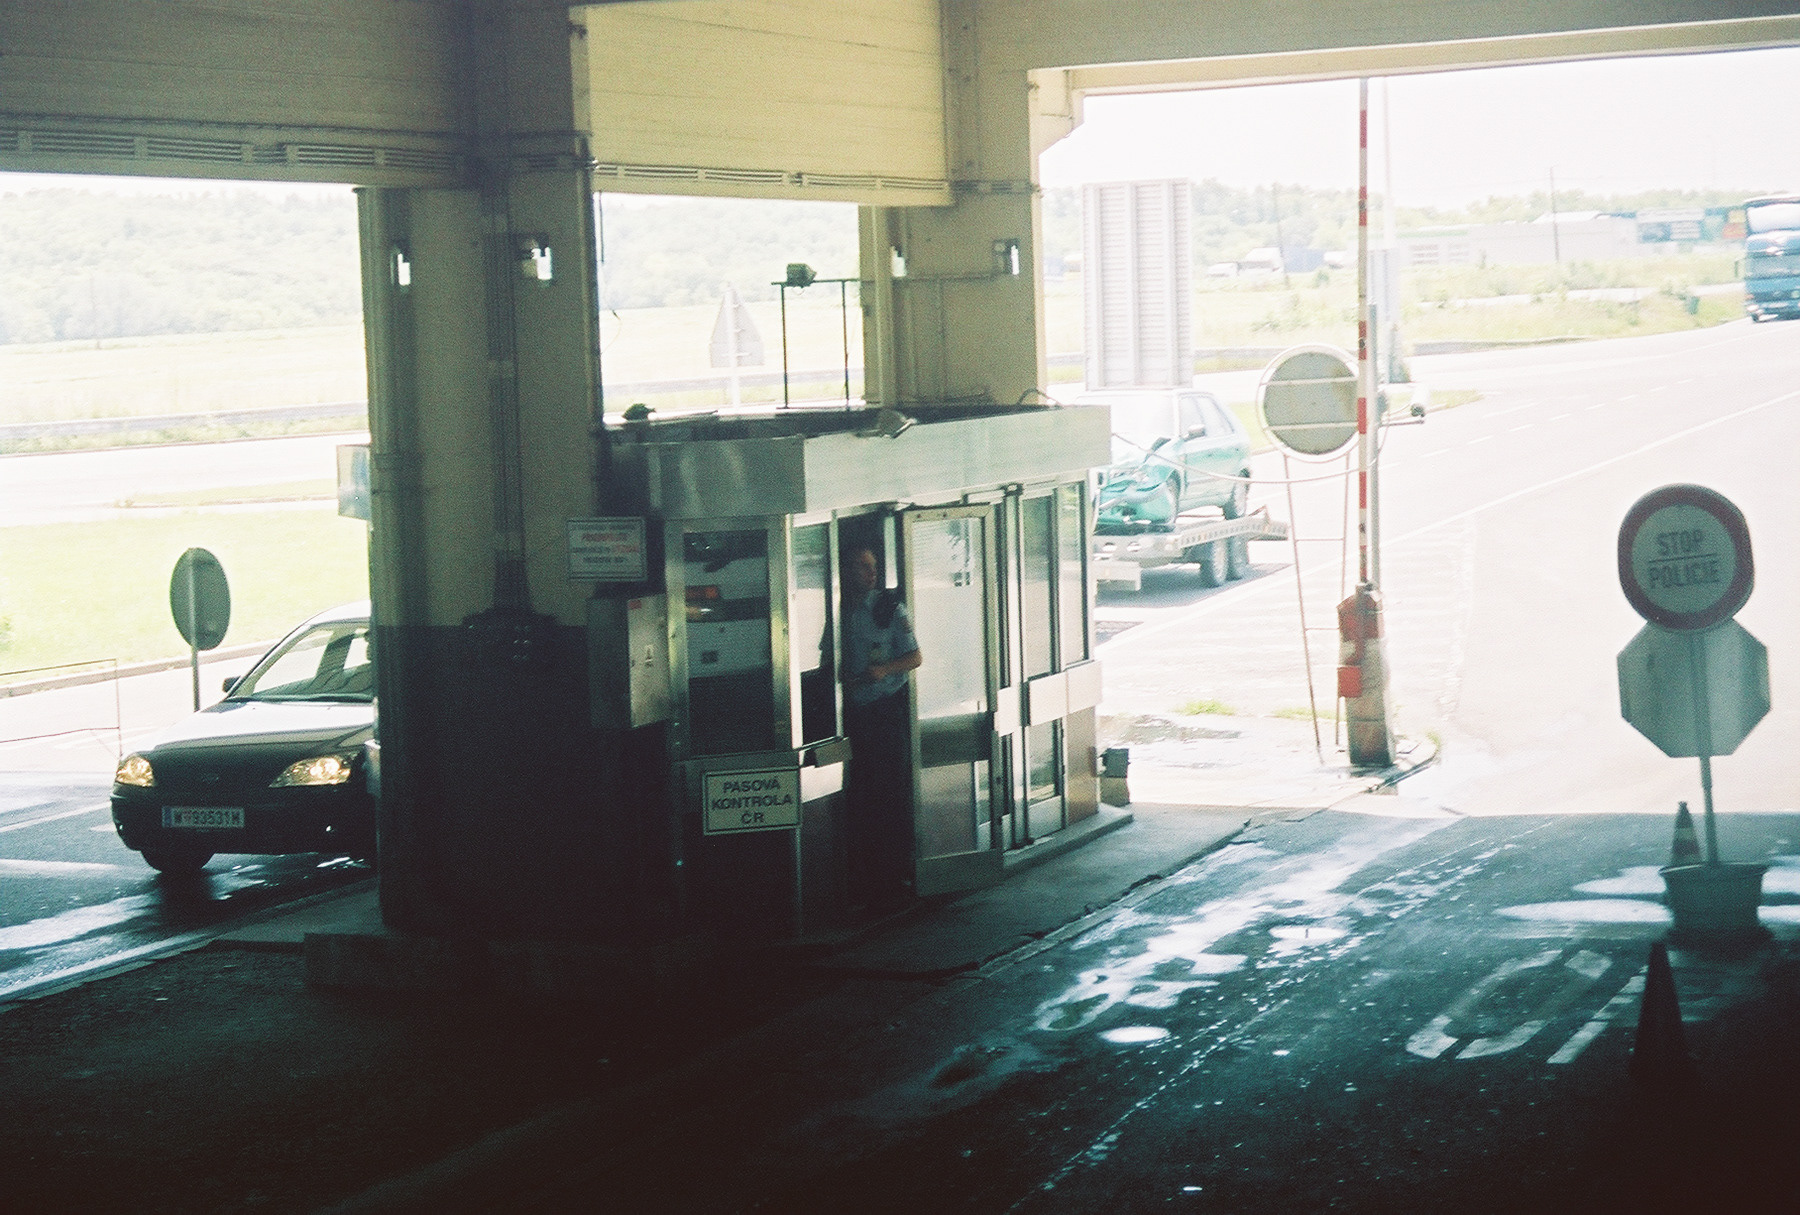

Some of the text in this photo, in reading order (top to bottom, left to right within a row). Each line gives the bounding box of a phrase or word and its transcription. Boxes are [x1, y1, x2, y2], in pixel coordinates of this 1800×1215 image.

[1656, 529, 1704, 556] STOP
[1647, 560, 1720, 589] POLICIE
[722, 776, 780, 794] PASOVÁ
[711, 794, 793, 811] KONTROLA
